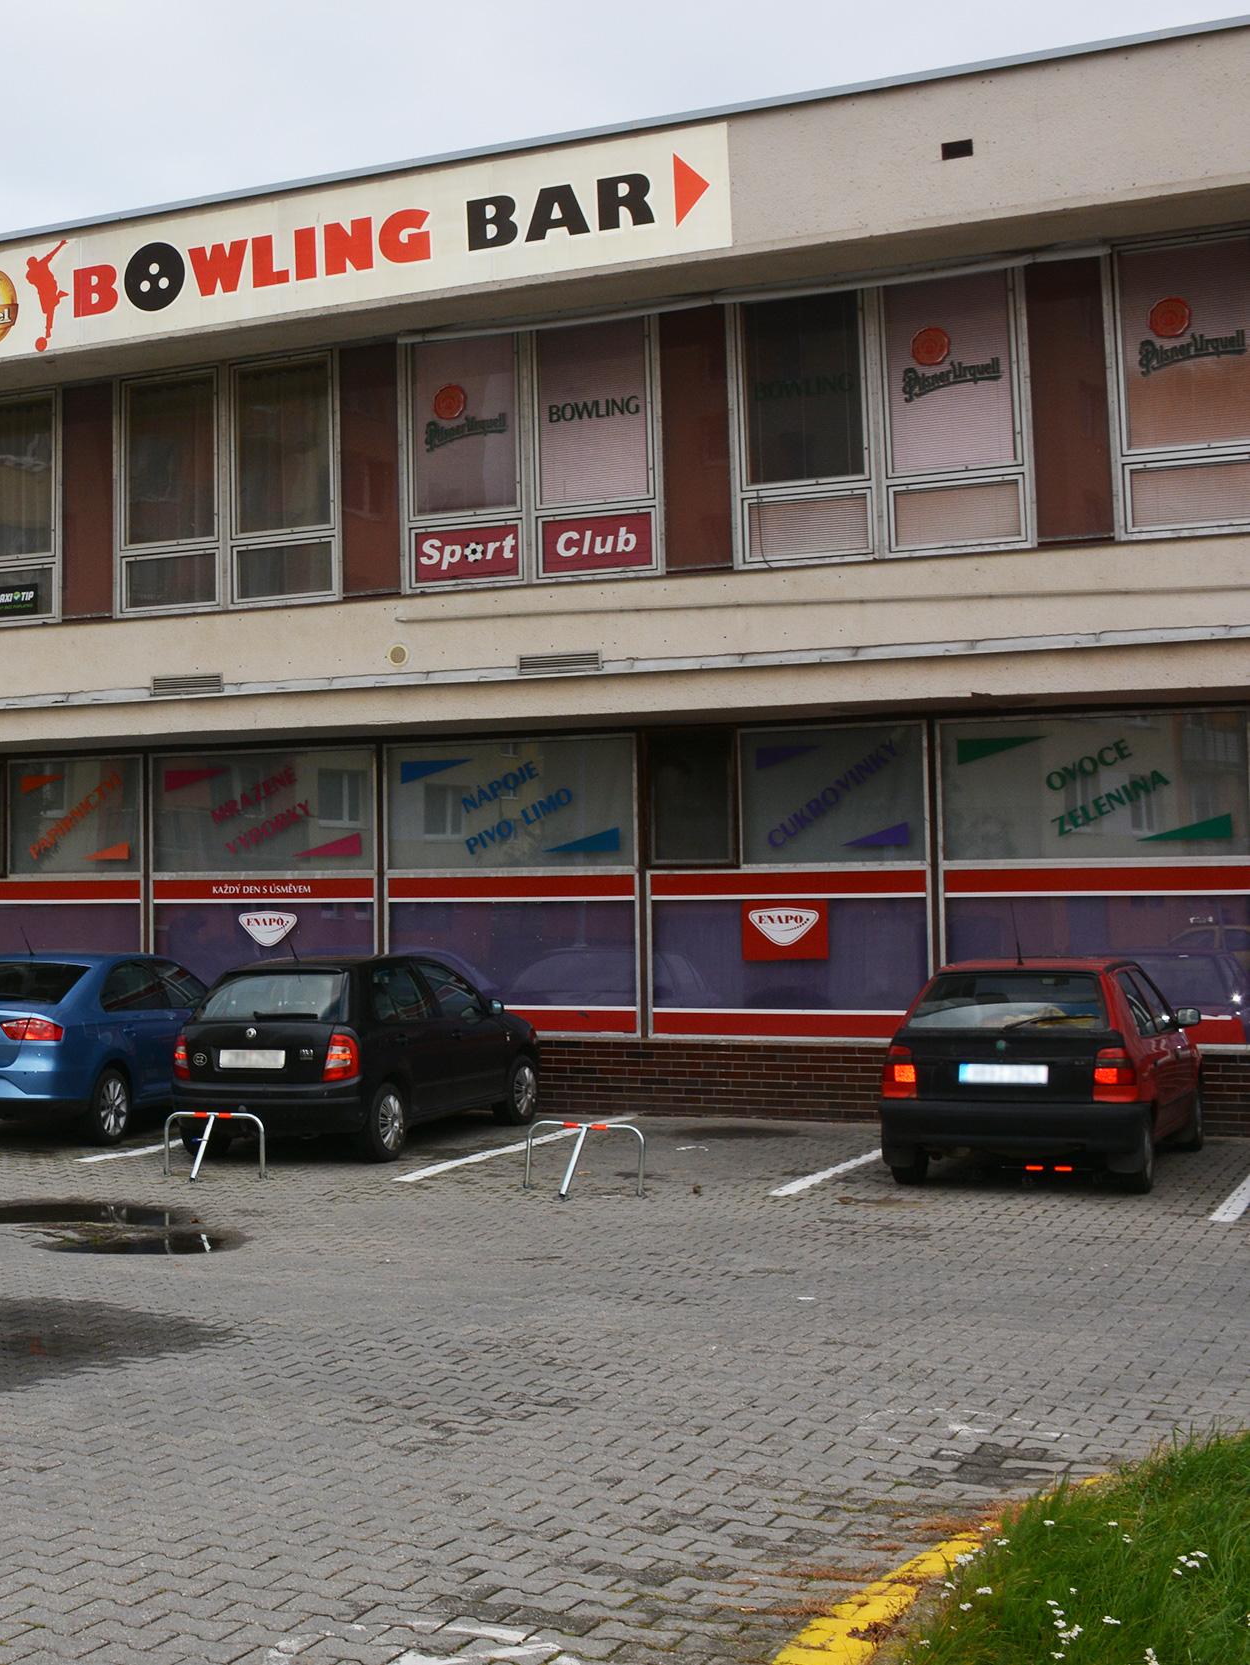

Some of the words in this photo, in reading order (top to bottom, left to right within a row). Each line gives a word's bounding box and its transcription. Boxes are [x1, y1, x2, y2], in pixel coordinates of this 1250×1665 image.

[73, 209, 432, 320] BOWLING
[467, 172, 655, 252] BAR
[1139, 339, 1191, 378] Pilsner
[1190, 329, 1247, 358] Urquell
[902, 367, 951, 403] Pilsner
[950, 357, 1003, 384] Urquell
[548, 395, 640, 424] BOWLING
[419, 533, 516, 570] Sport
[556, 526, 637, 557] Club
[21, 591, 34, 601] TIP
[1045, 739, 1133, 791] OVOCE
[520, 787, 574, 826] LIMO
[767, 737, 897, 848] CUKROVINKY
[1050, 769, 1171, 837] ZELENINA
[212, 883, 241, 894] KAŽDÝ
[243, 885, 261, 894] DEN
[262, 885, 268, 894] S
[269, 882, 312, 894] ÚSMĚVEM
[246, 916, 285, 926] ENAPO
[757, 913, 805, 924] ENAPO
